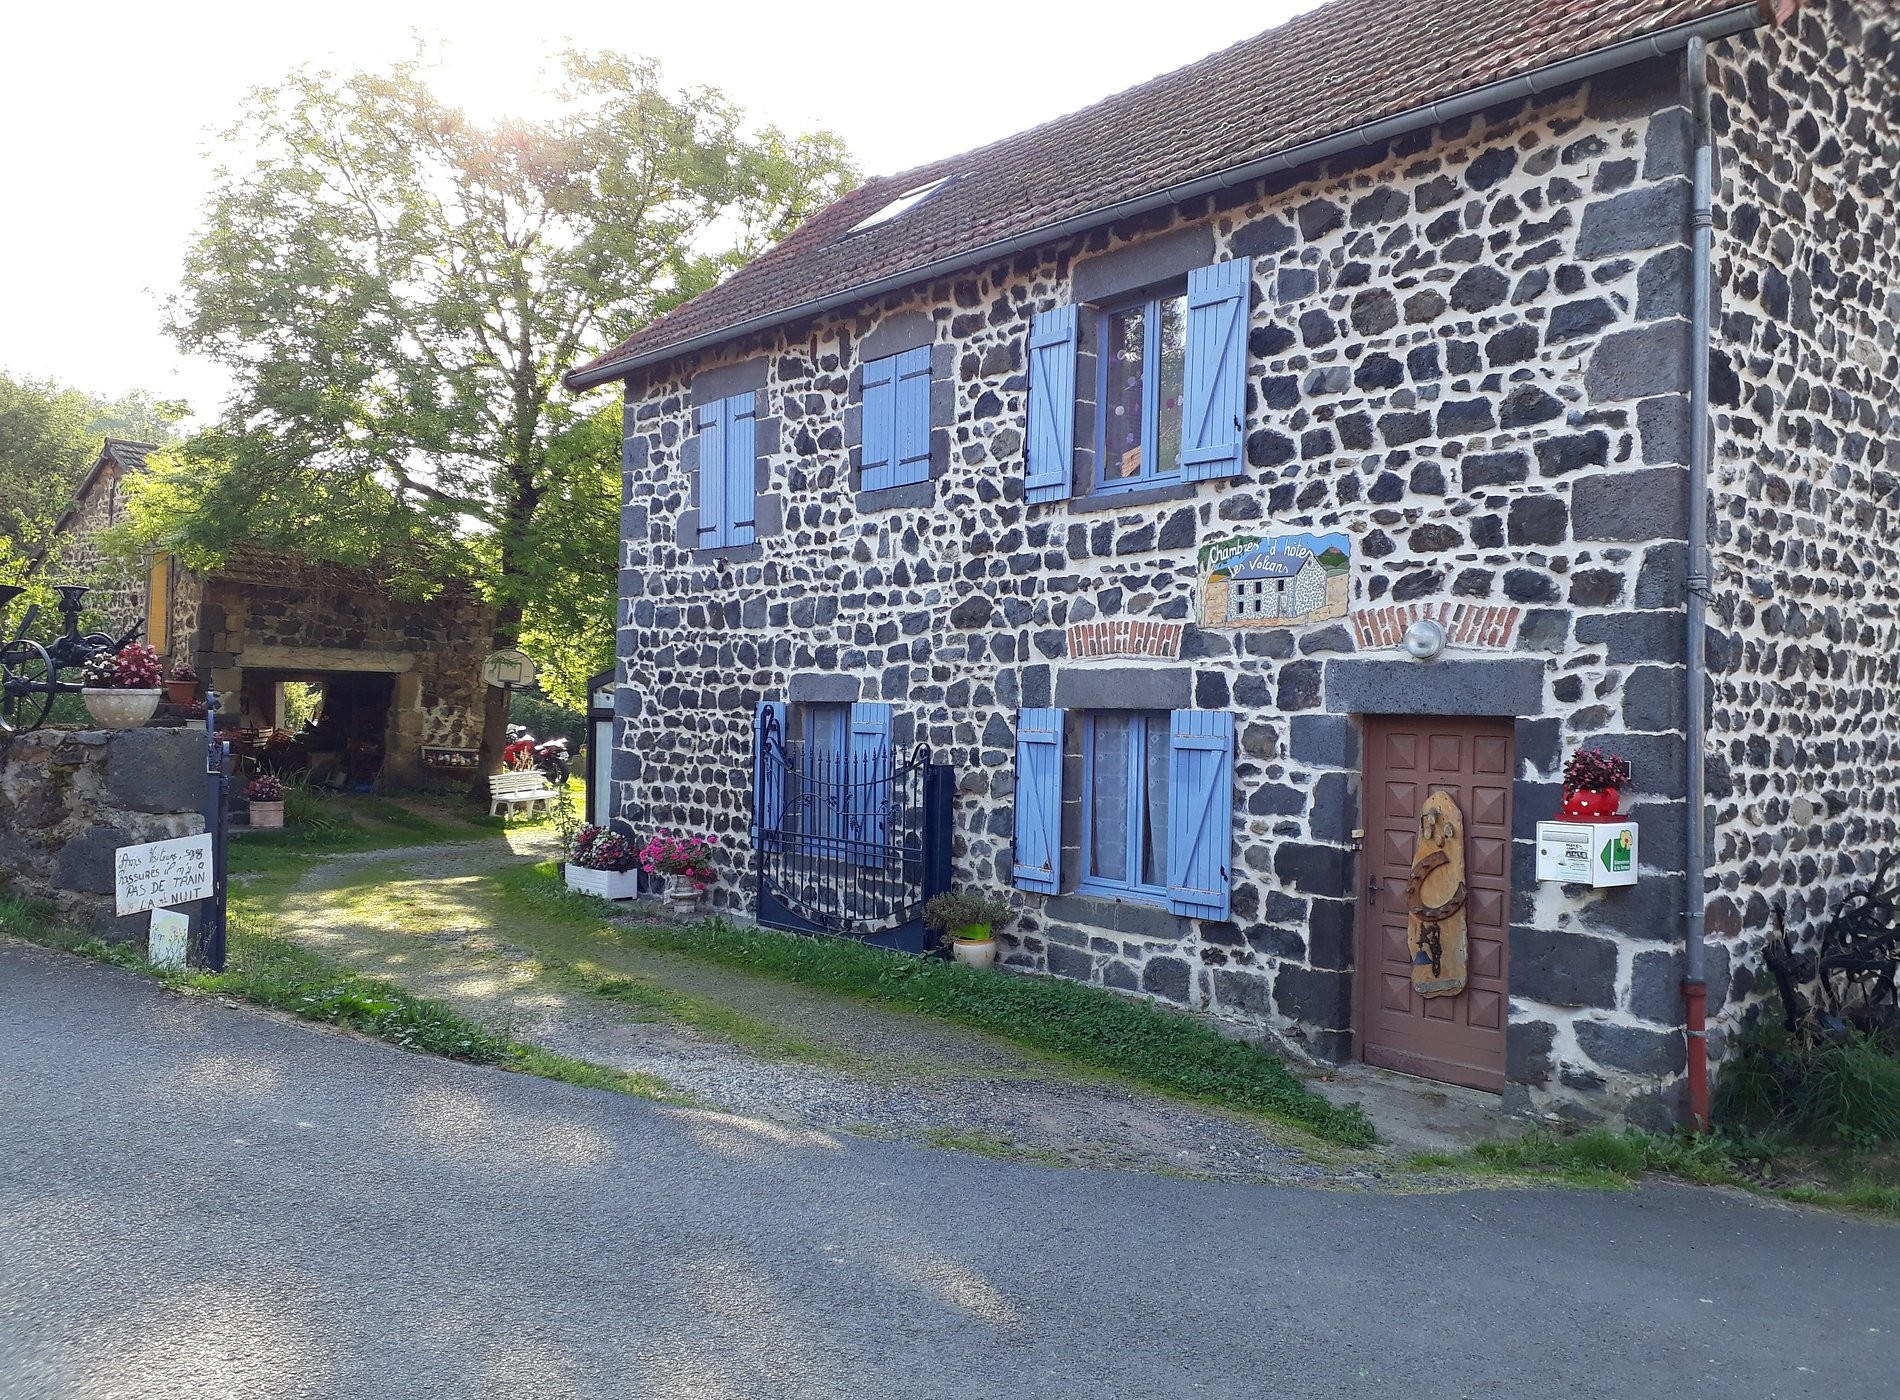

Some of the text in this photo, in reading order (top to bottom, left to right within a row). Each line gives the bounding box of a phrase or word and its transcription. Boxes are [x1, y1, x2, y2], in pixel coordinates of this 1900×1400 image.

[1209, 539, 1259, 563] Chambres
[1249, 553, 1289, 574] Volcans
[126, 871, 206, 899] PAS DE TRAIN
[140, 887, 202, 911] LA NUIT
